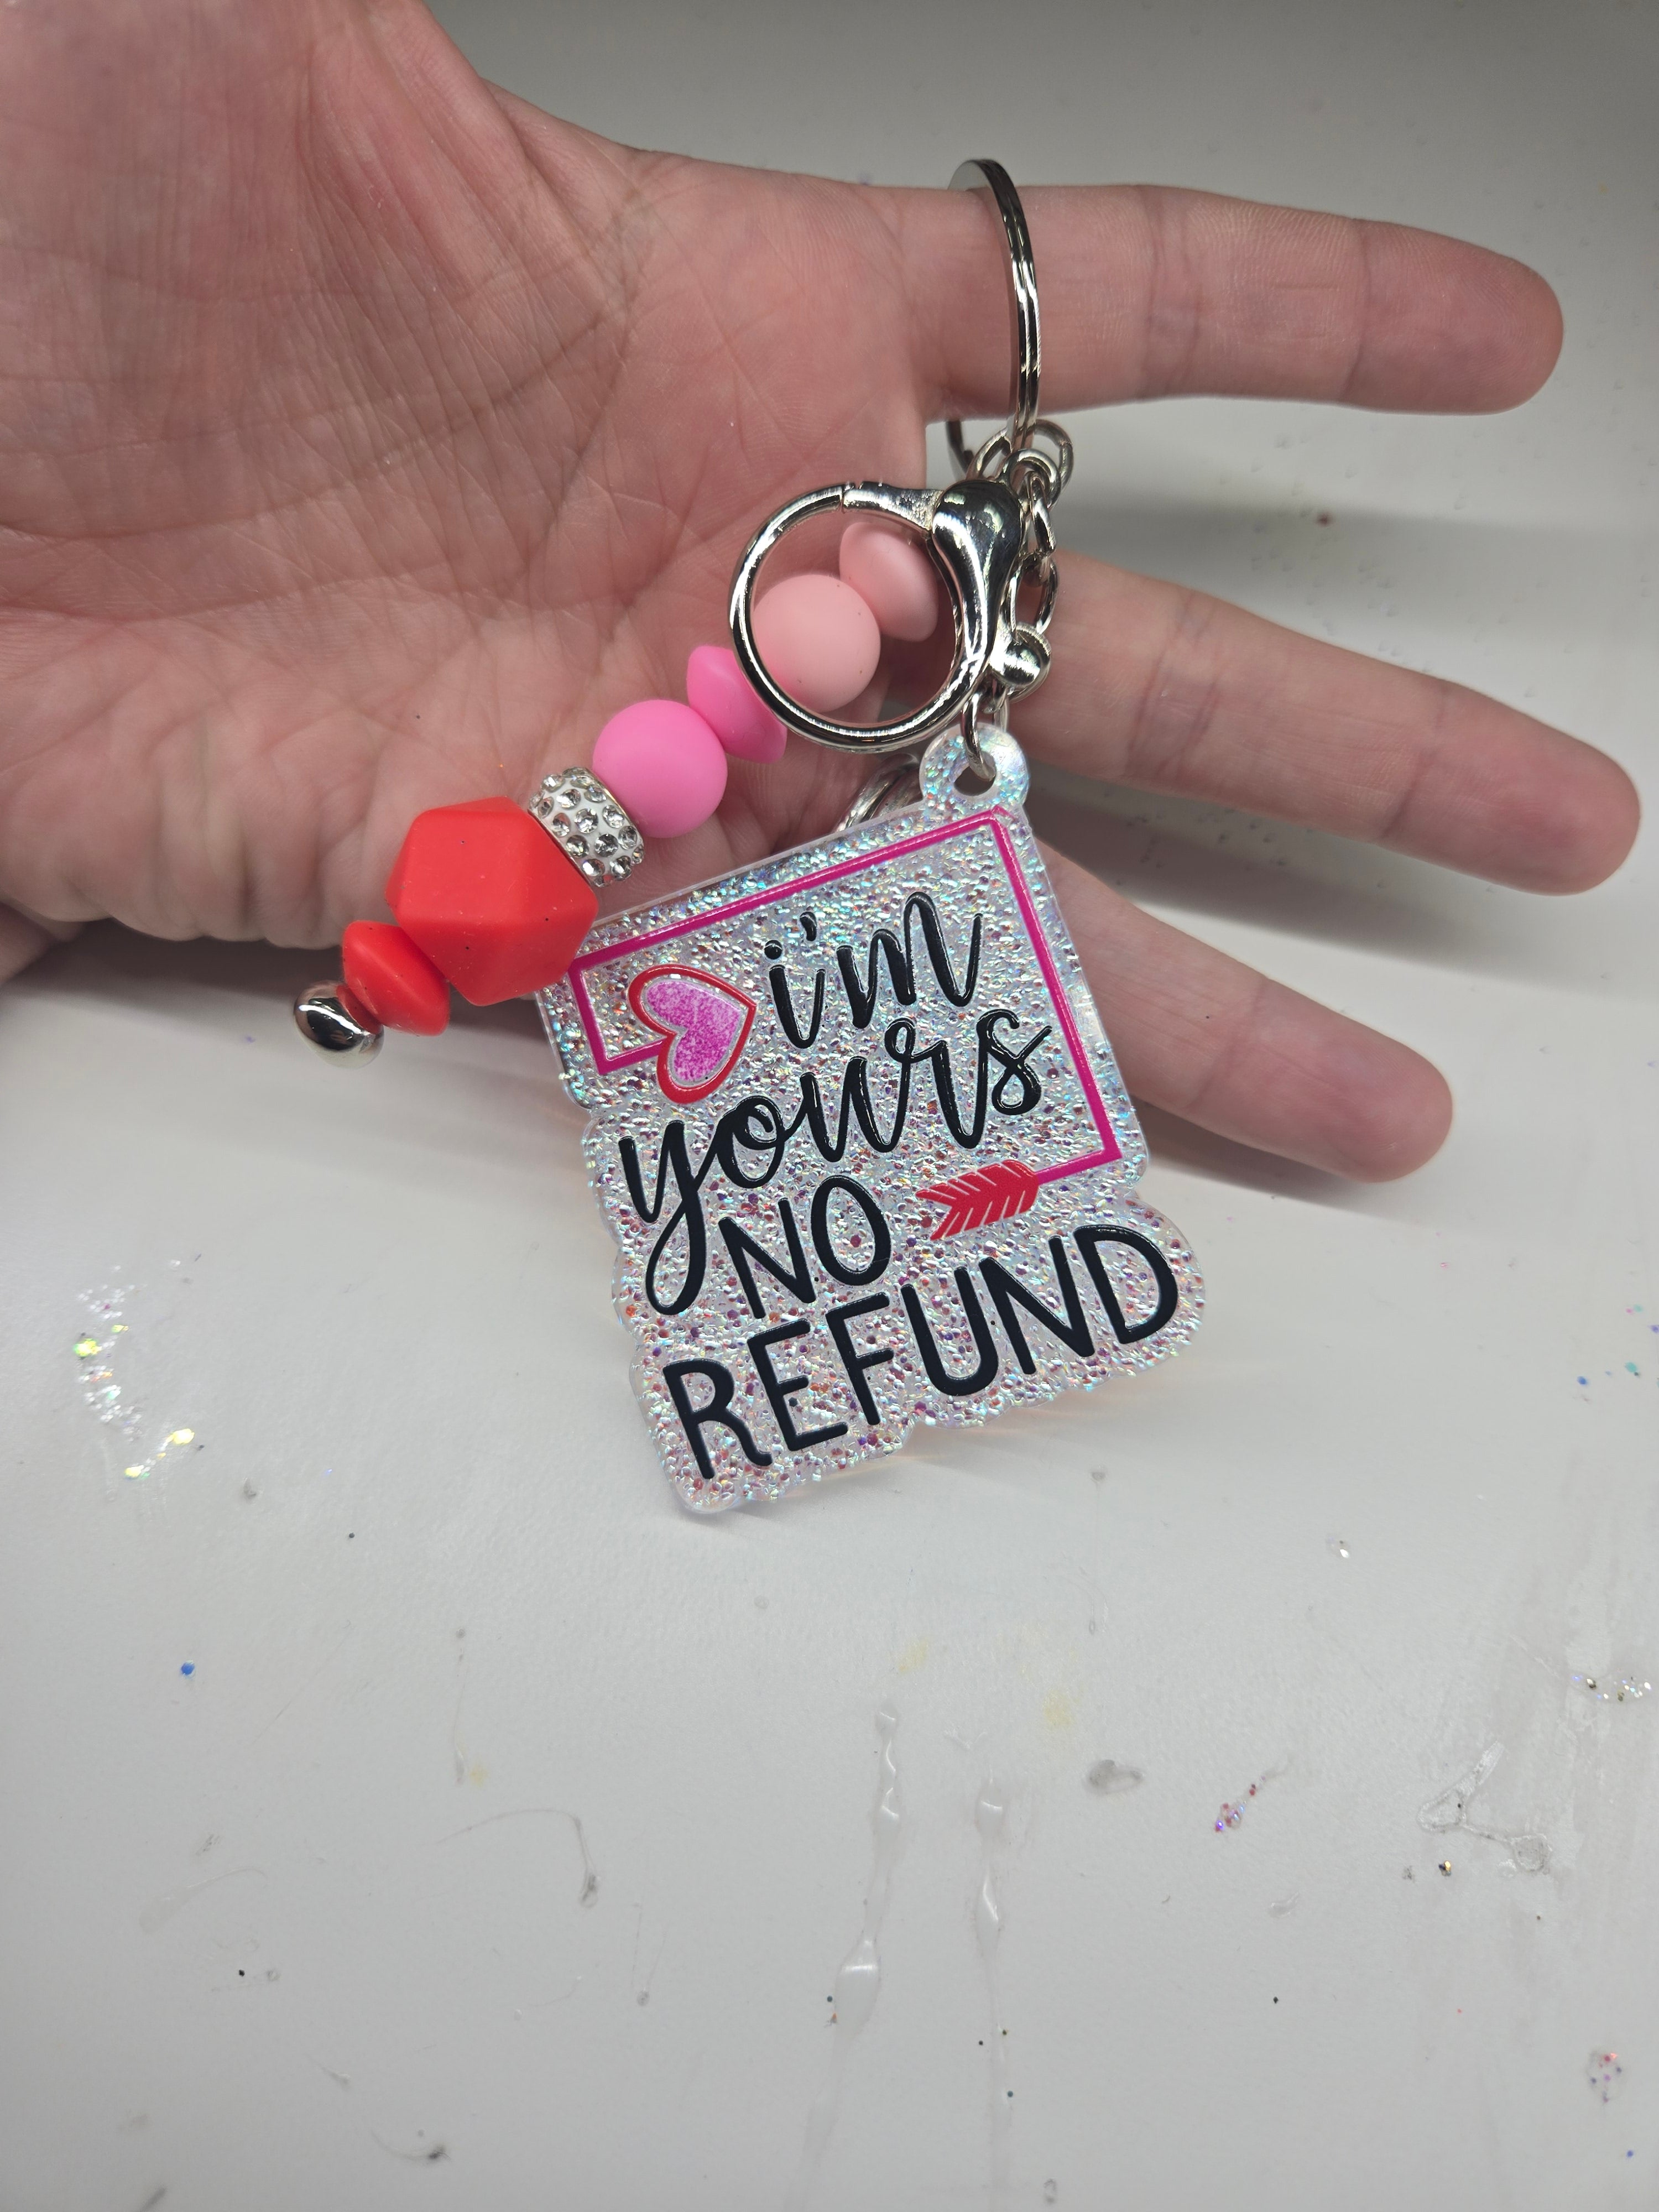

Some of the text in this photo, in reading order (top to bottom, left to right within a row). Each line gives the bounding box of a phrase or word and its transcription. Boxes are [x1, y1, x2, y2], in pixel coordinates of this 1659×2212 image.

[765, 892, 983, 1049] i'm
[619, 1010, 1052, 1316] yours
[718, 1176, 892, 1319] NO
[663, 1225, 1178, 1479] REFUND
